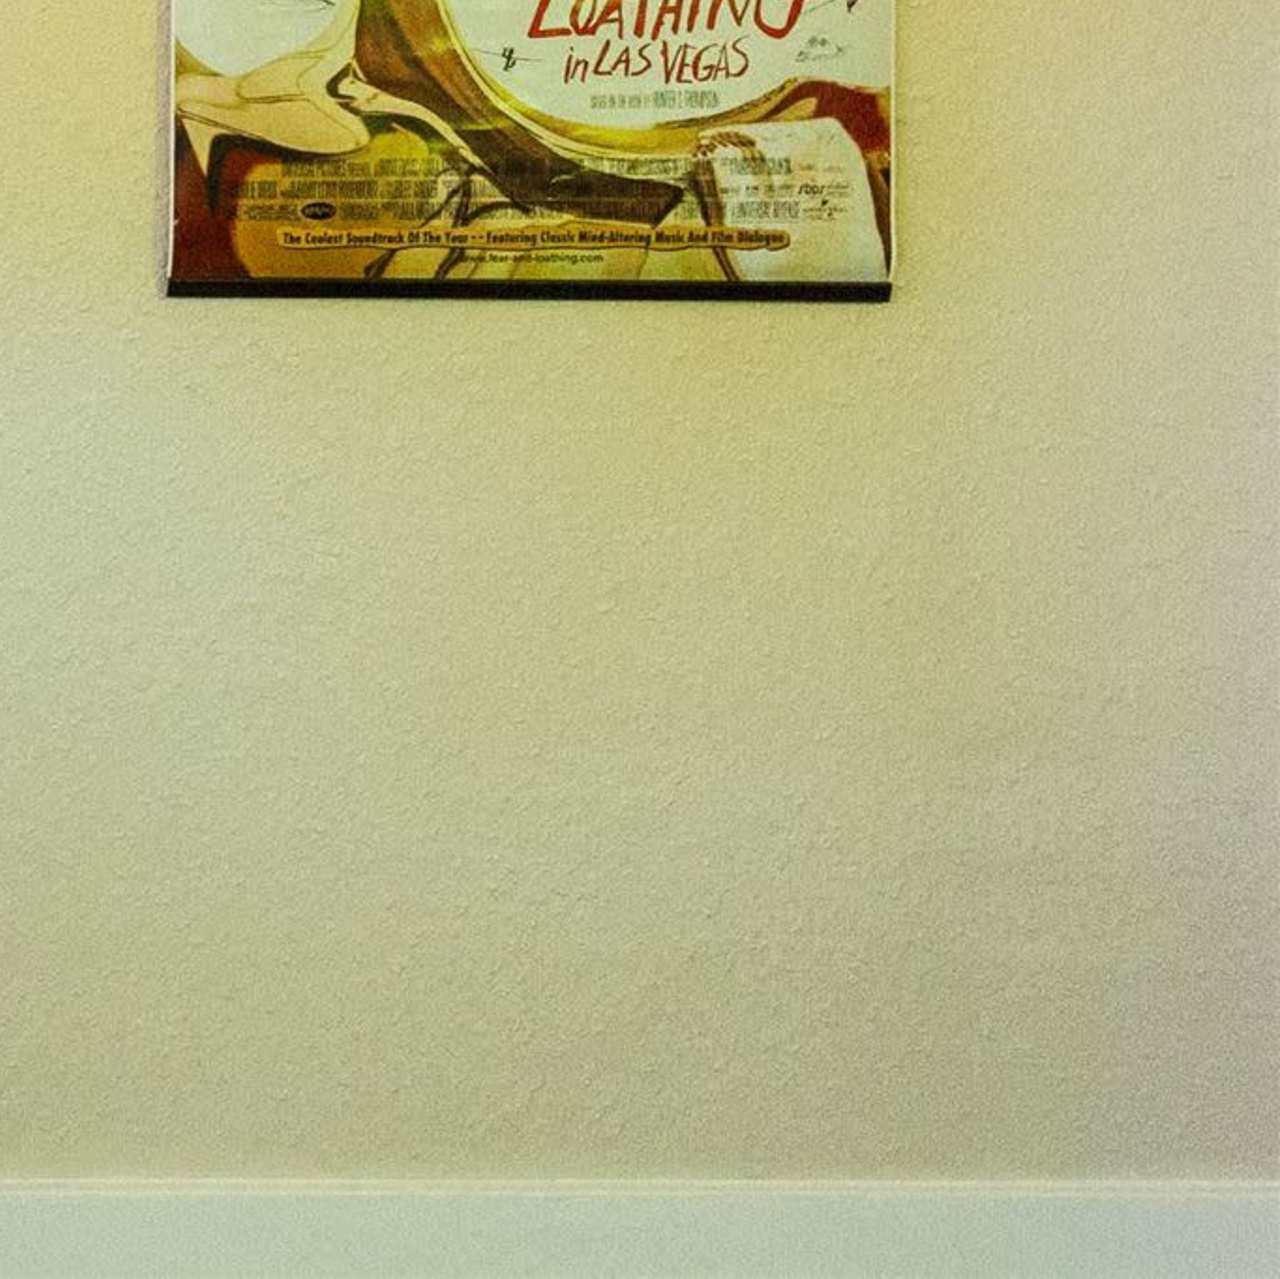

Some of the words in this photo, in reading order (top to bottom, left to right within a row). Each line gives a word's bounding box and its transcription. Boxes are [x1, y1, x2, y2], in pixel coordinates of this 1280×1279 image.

[562, 46, 590, 84] in
[592, 40, 653, 77] LAS
[659, 36, 751, 84] VEGAS
